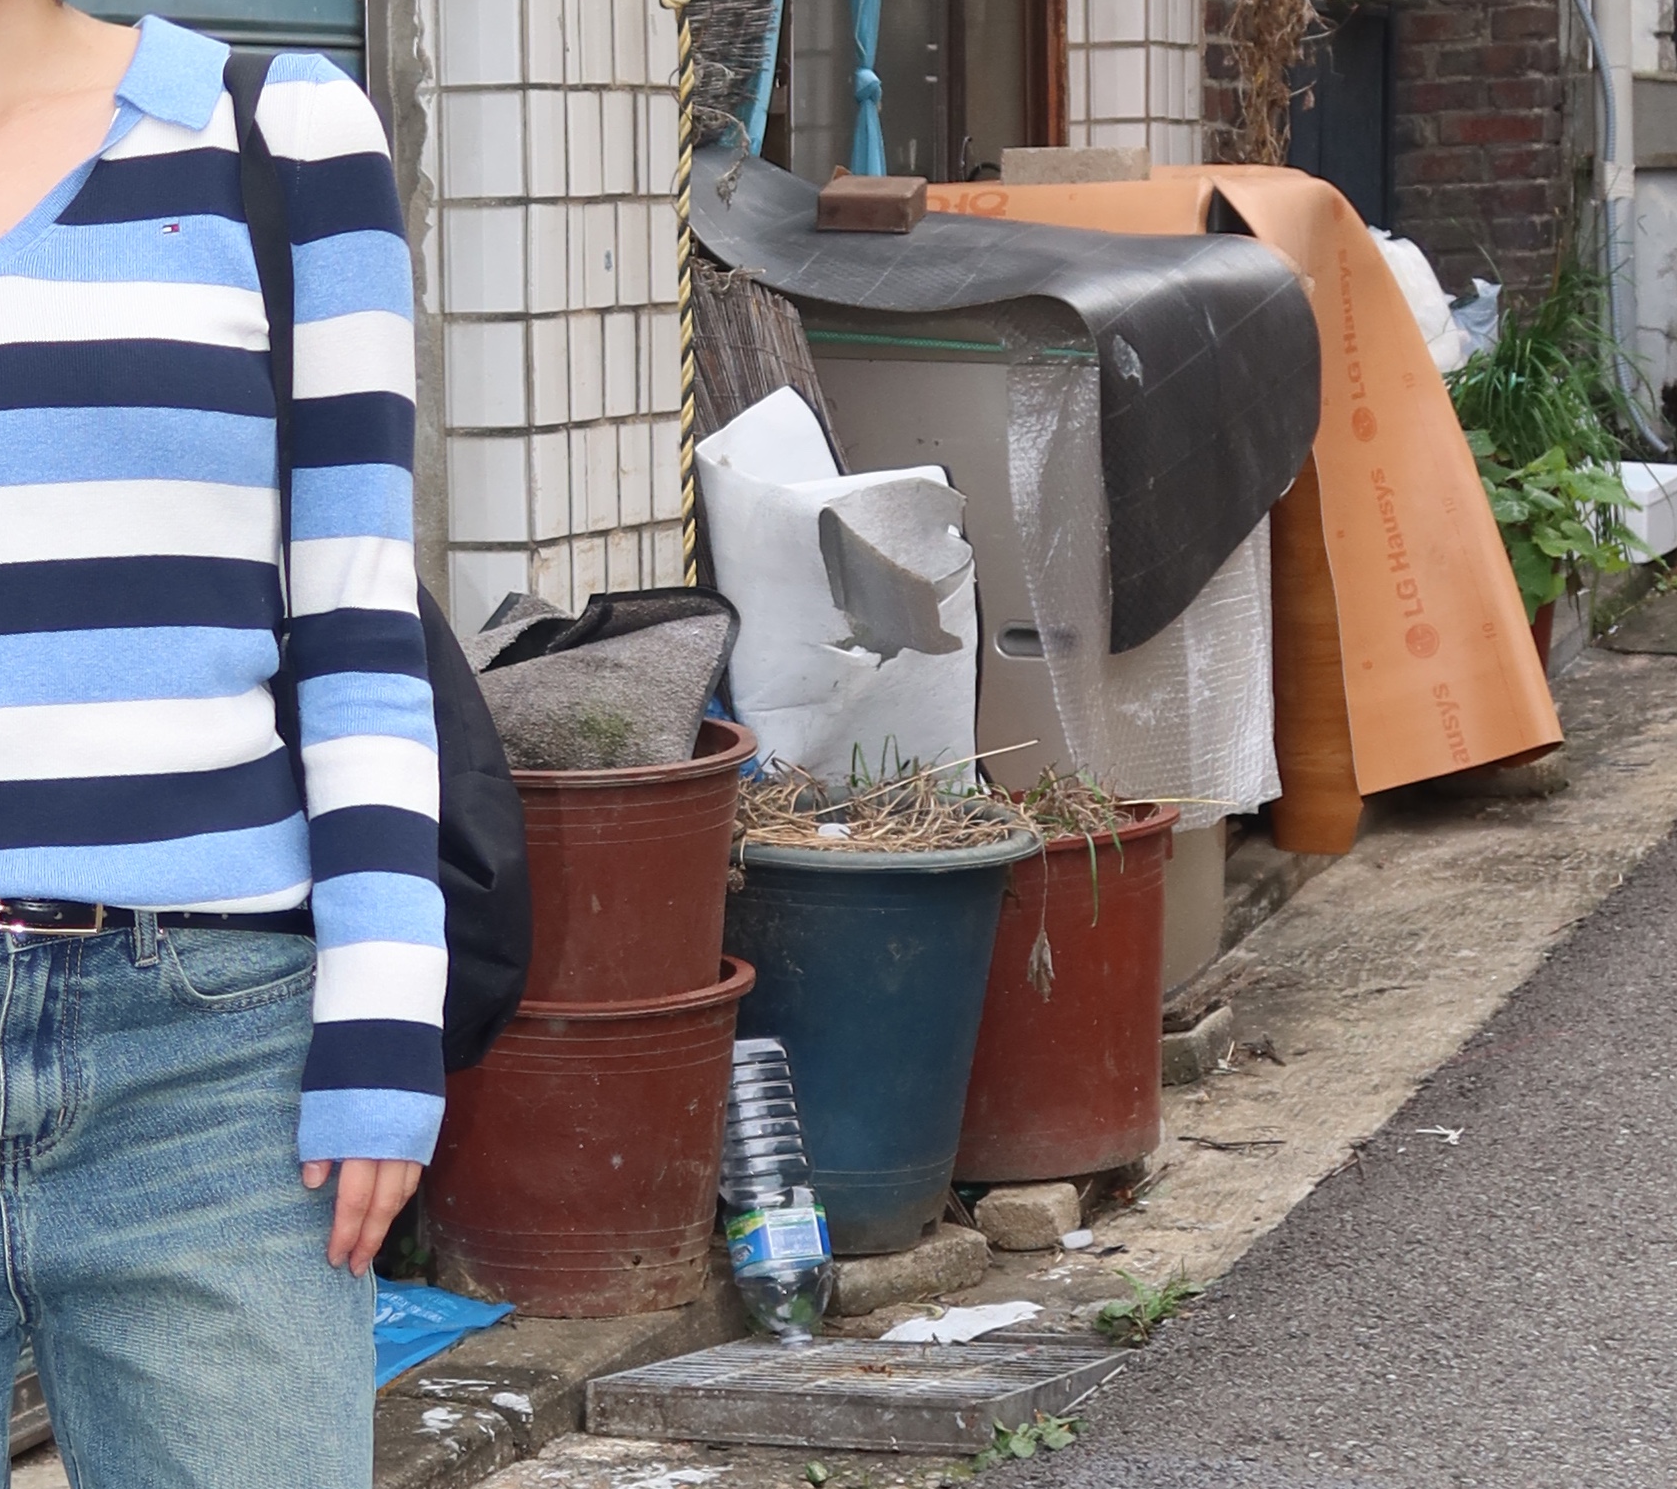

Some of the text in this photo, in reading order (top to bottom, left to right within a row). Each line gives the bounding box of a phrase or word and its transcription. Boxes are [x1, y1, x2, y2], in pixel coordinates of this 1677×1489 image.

[1338, 249, 1366, 400] LG Hausys
[1371, 468, 1424, 618] LG Hausys
